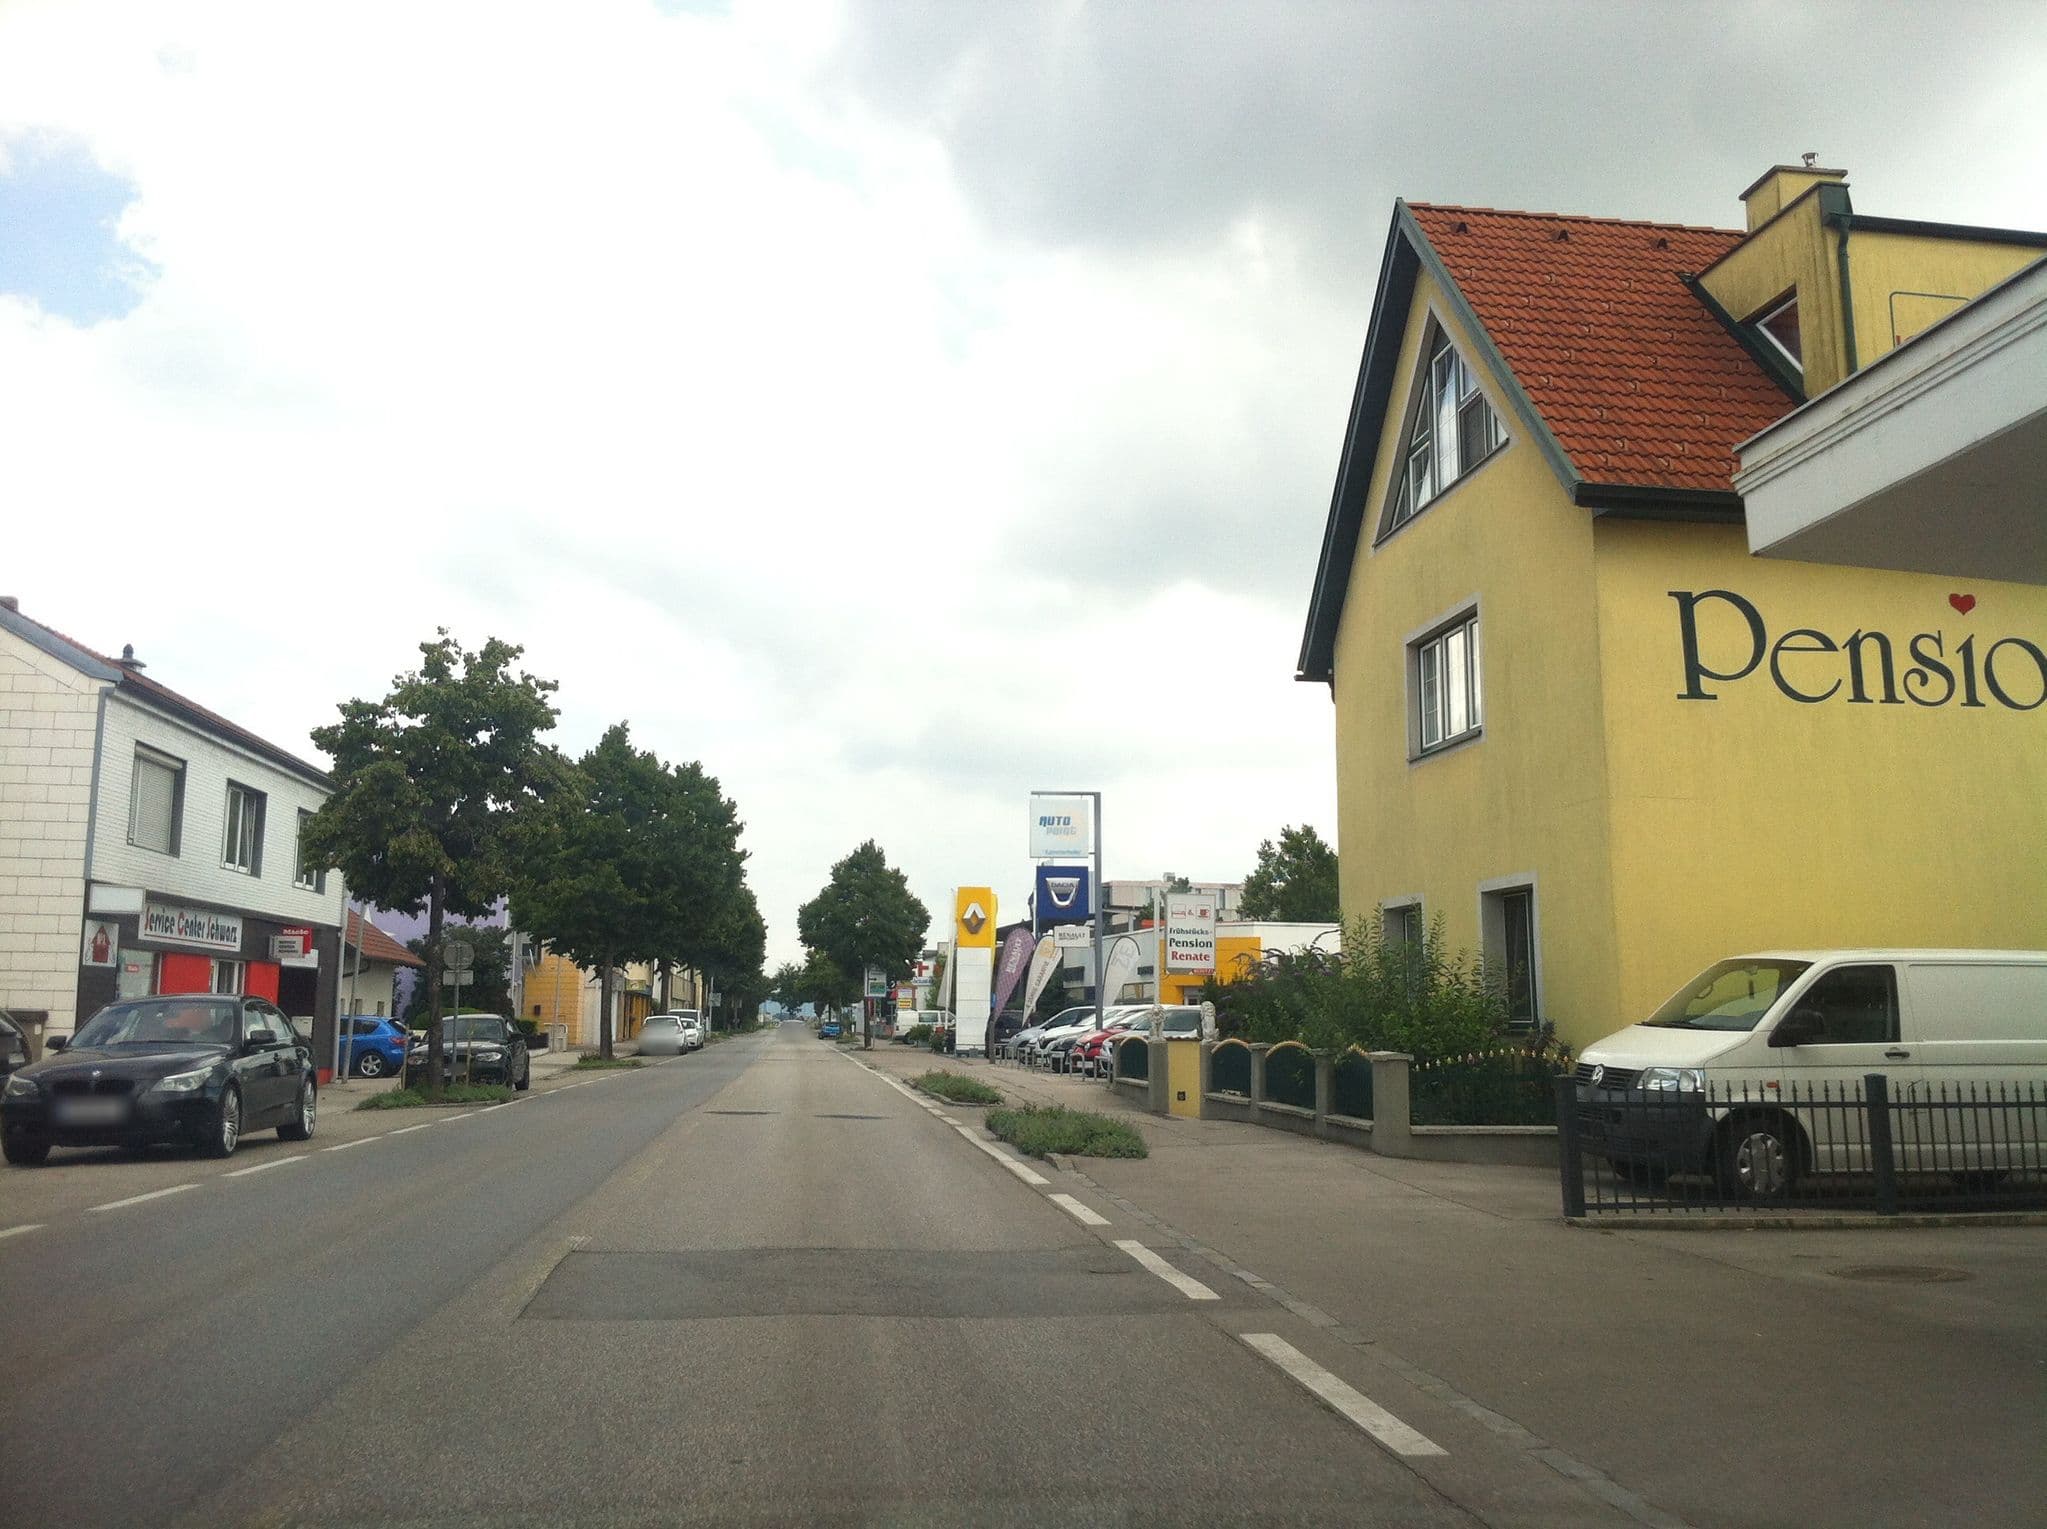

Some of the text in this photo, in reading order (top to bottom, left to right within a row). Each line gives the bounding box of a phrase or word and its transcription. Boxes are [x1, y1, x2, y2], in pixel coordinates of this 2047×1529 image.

[1039, 815, 1071, 827] AUTO
[145, 905, 238, 943] Service Center Schwarz
[1169, 937, 1213, 948] Pension
[1171, 950, 1210, 962] Renate
